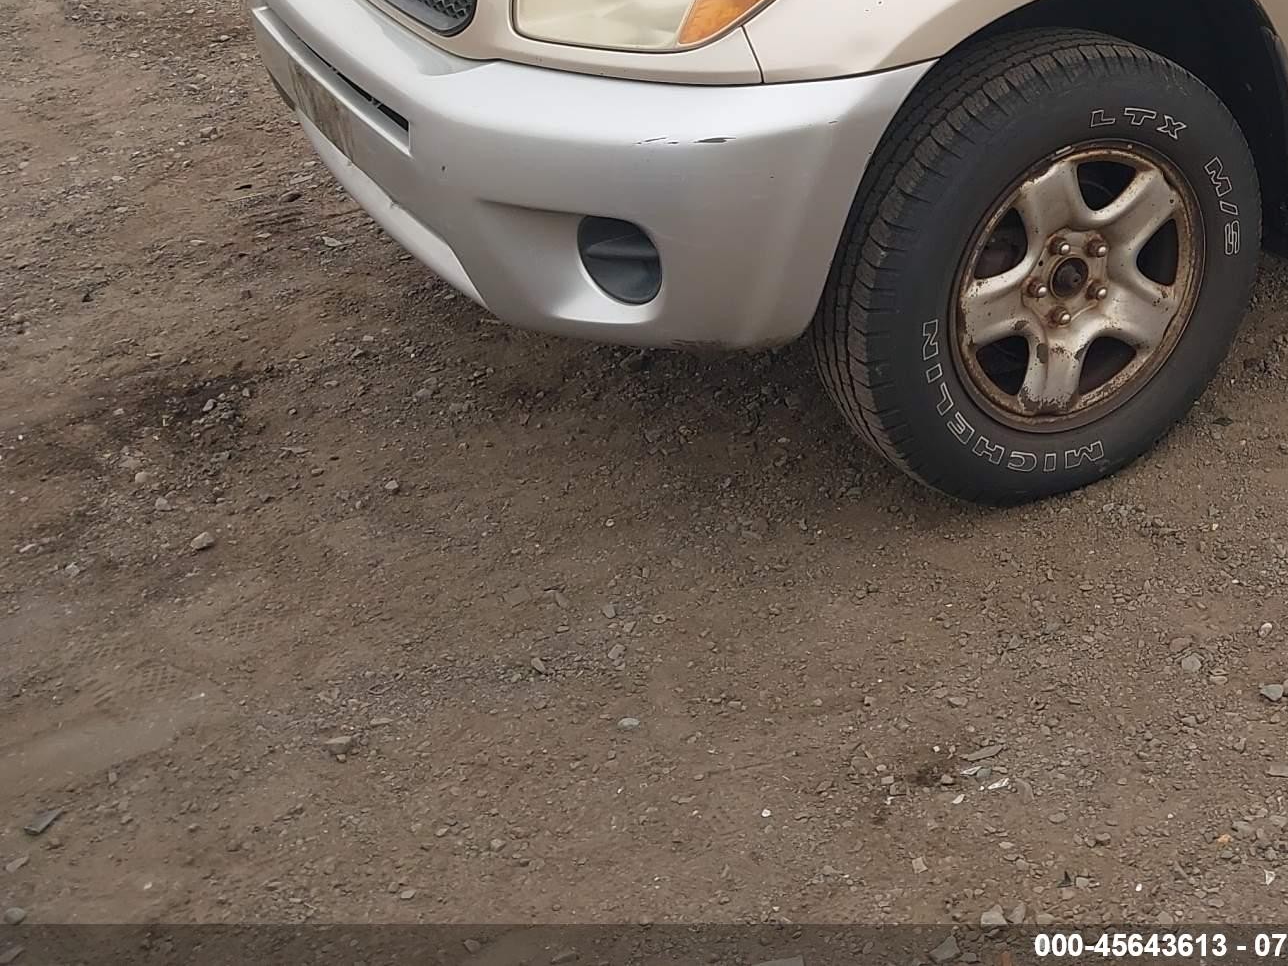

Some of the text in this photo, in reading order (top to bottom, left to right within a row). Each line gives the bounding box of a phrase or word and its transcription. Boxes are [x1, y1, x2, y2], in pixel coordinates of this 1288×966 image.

[1090, 107, 1241, 255] LTX M/S
[922, 318, 1105, 473] MICHELIN
